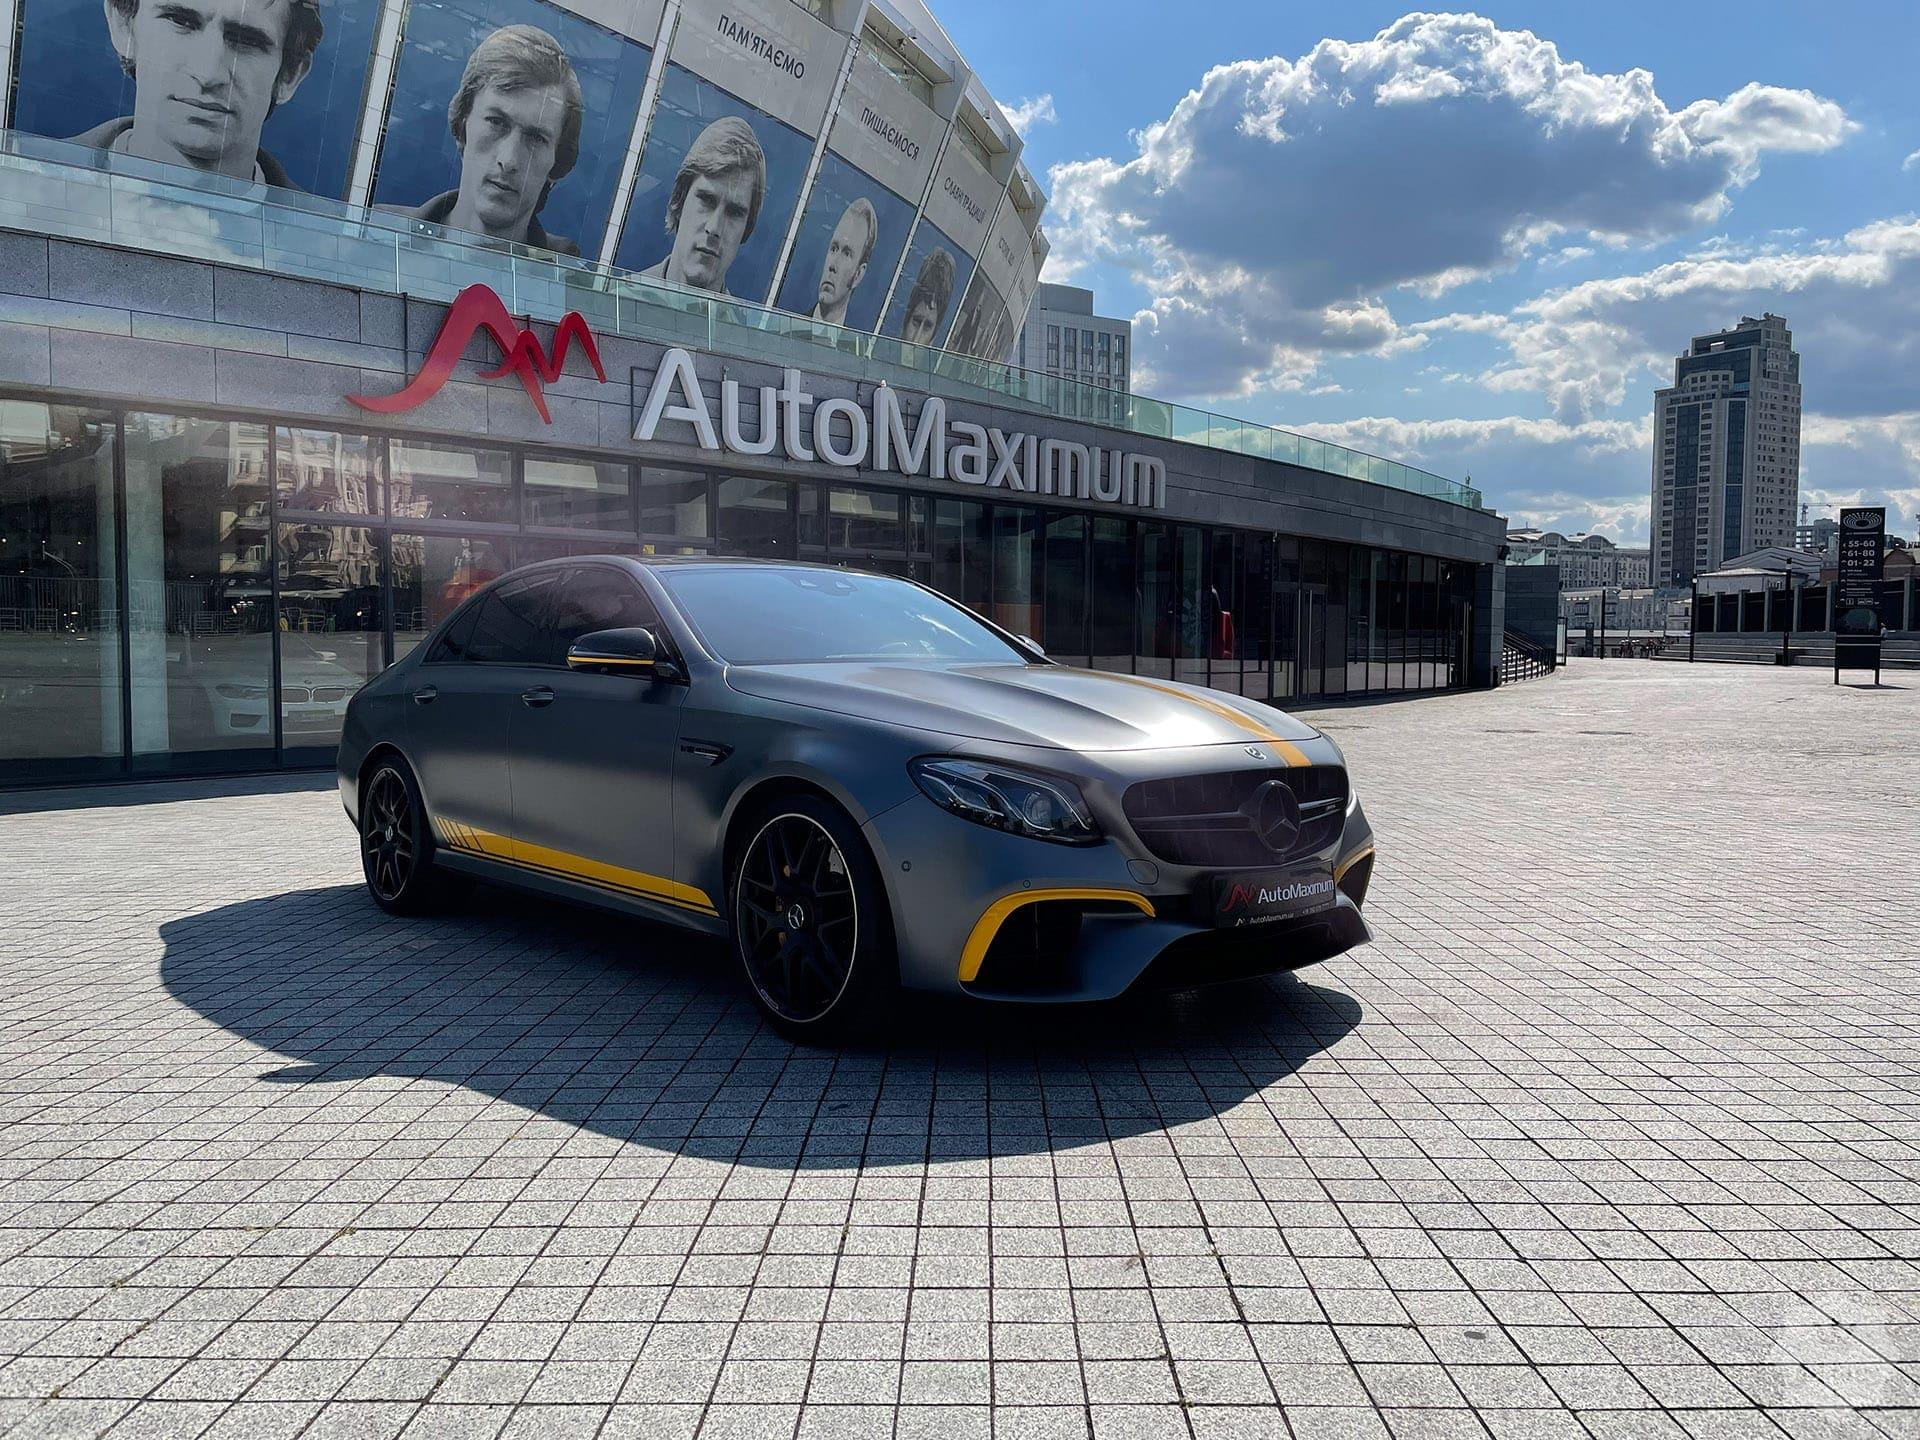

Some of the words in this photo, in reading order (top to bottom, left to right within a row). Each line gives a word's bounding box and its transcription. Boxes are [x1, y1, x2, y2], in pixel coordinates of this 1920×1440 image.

[717, 14, 805, 79] ПАМ'ЯТАЄМО
[860, 106, 920, 161] ПИШАЄМОСЯ
[633, 348, 1166, 509] AutoMaximum
[1848, 540, 1876, 548] 55-60
[1258, 880, 1334, 904] AutoMaximum
